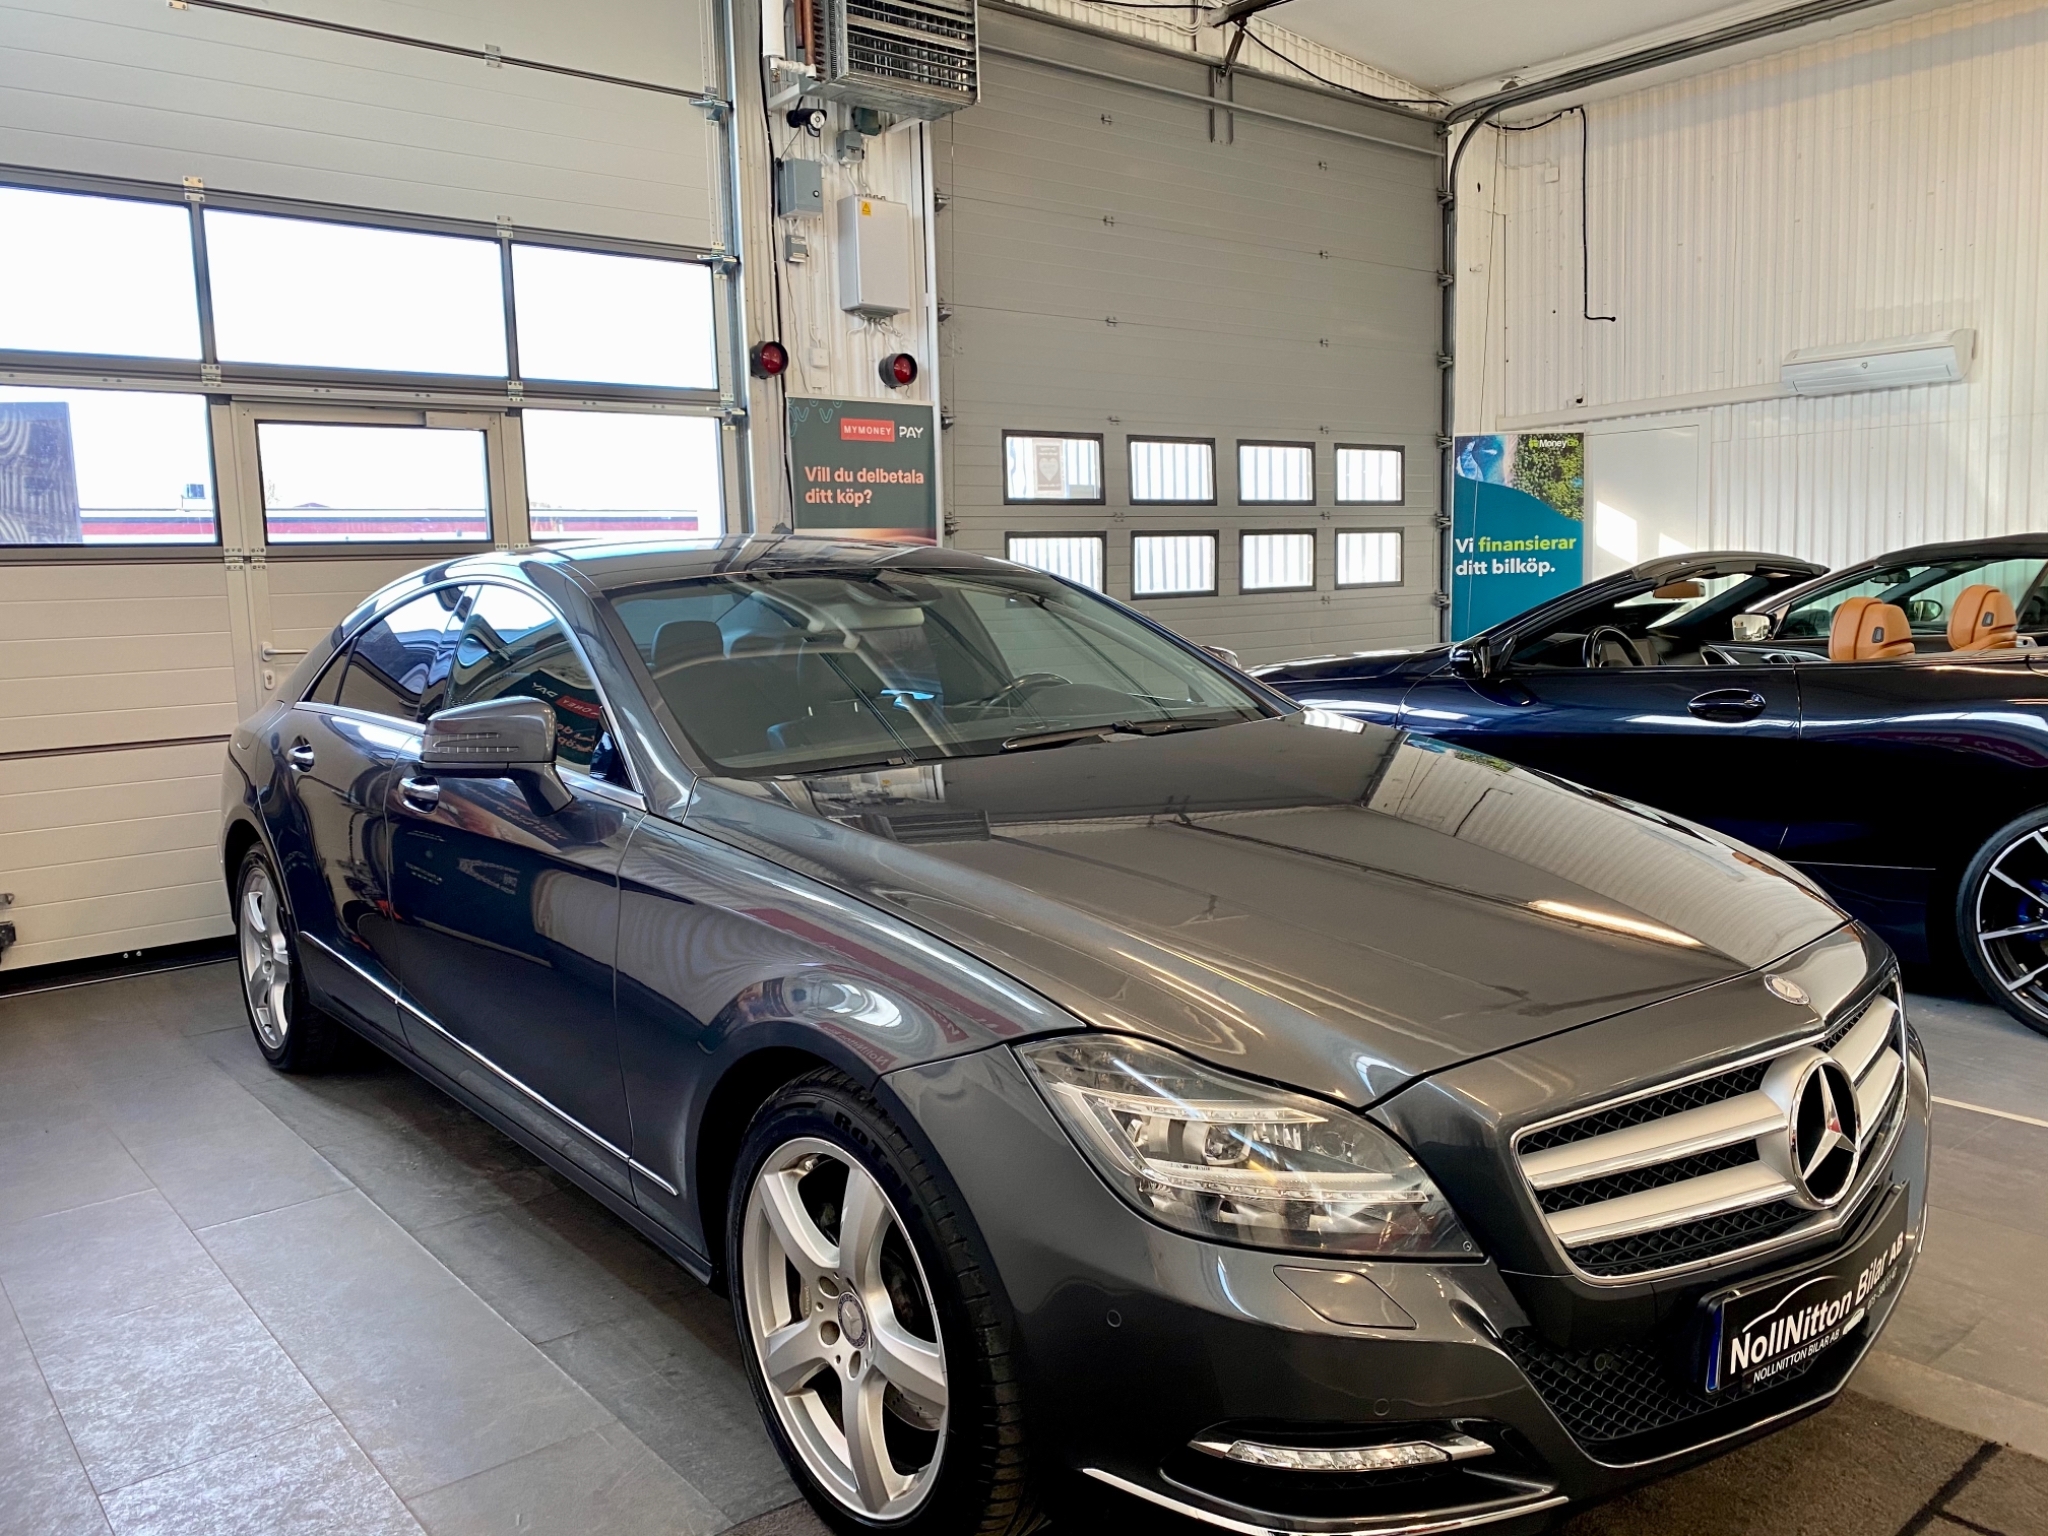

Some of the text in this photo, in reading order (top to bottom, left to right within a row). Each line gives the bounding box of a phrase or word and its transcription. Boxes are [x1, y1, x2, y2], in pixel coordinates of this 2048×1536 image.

[843, 425, 924, 439] MYMONEY PAY
[804, 466, 925, 484] Vill du delbetala
[805, 488, 873, 507] ditt köp?
[1455, 535, 1577, 553] Vi finansierar
[1455, 558, 1556, 577] ditt bilköp.
[1730, 1290, 1853, 1375] NollNitton
[1855, 1249, 1888, 1306] Bilar
[1888, 1231, 1904, 1266] AB
[1753, 1328, 1840, 1384] NOLLNITTON BILAR AB
